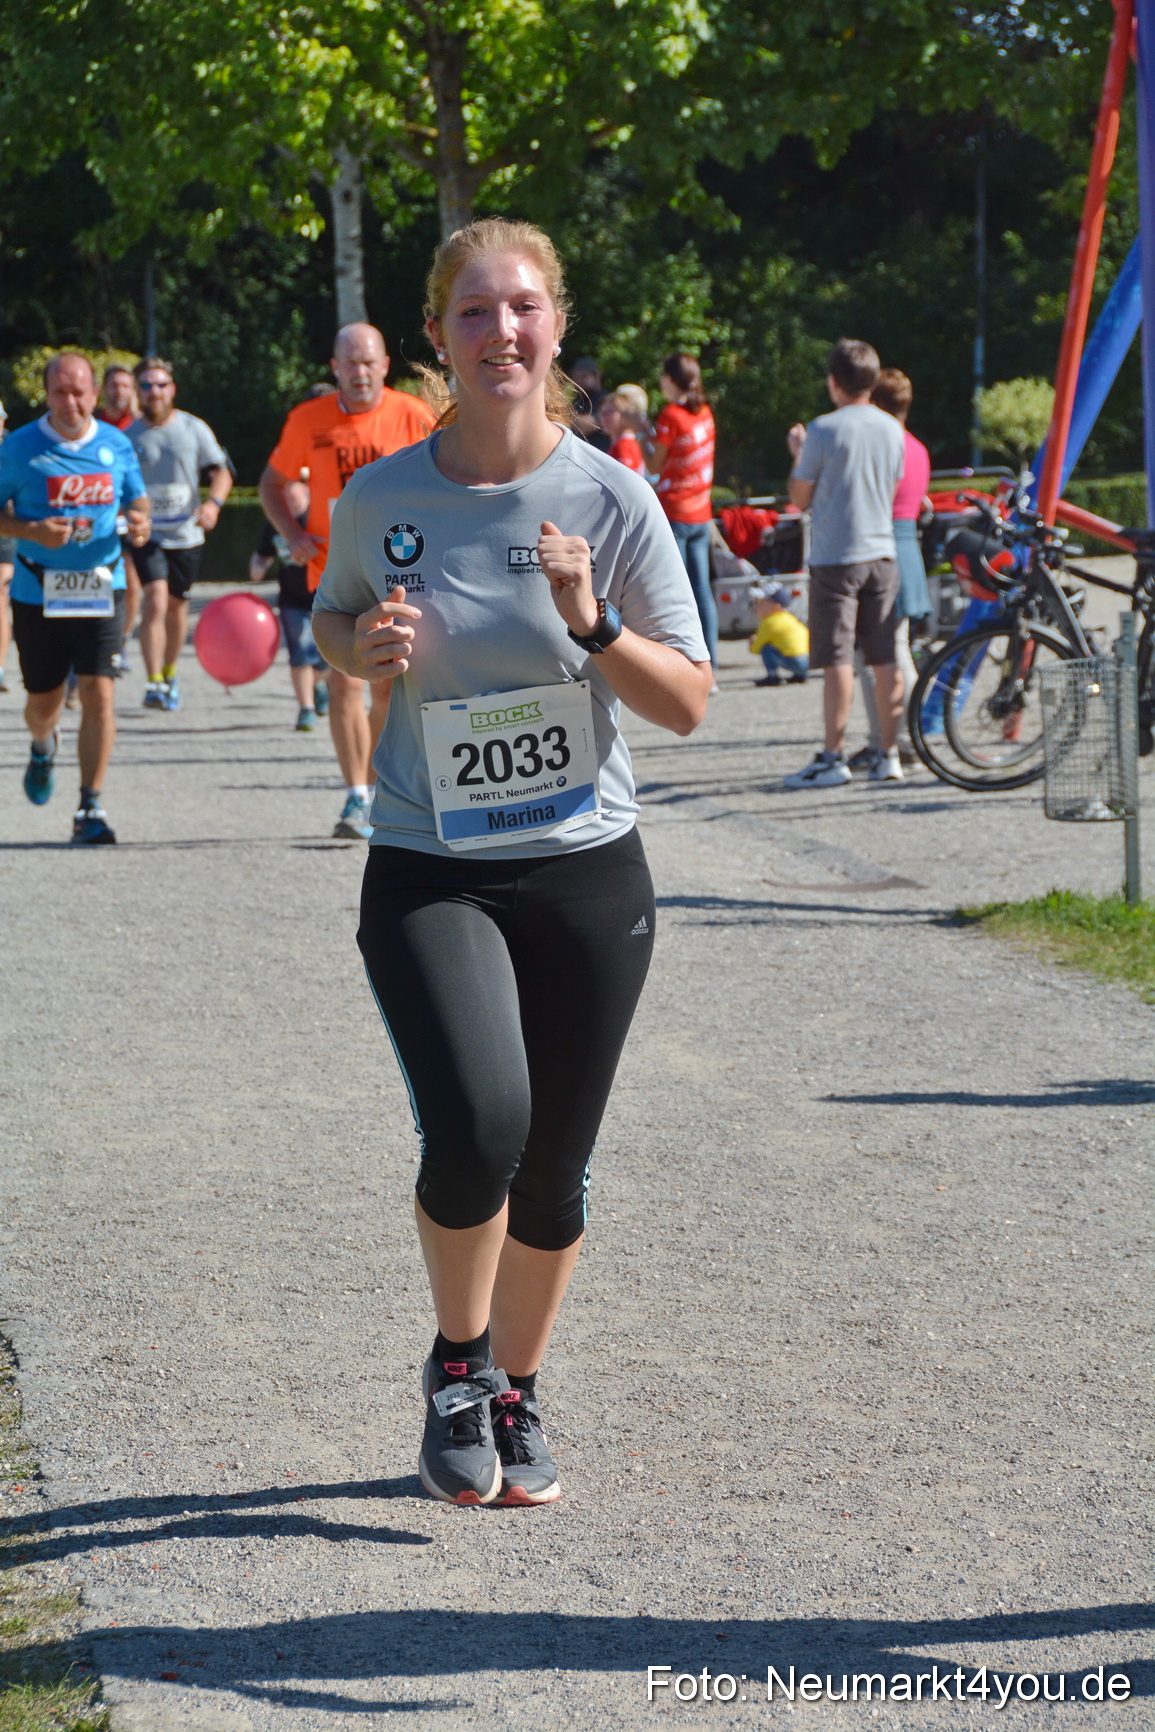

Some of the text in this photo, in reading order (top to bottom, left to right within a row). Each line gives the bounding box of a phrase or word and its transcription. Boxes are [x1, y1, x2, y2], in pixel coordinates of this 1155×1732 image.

[336, 444, 384, 469] RUN
[49, 474, 114, 506] Lete
[386, 524, 422, 540] BMW
[384, 573, 426, 586] PARTL
[507, 566, 535, 575] inspired
[54, 572, 102, 590] 2073
[470, 701, 544, 729] BOCK
[471, 727, 495, 735] inspired
[503, 722, 520, 730] smart
[520, 717, 545, 727] concepts
[452, 725, 571, 787] 2033
[469, 781, 554, 802] PARTL Neumarkt
[487, 804, 556, 831] Marina
[631, 927, 649, 935] adidas
[446, 1364, 465, 1373] NIKE
[446, 1391, 460, 1401] 2033
[500, 1392, 518, 1400] NIKE
